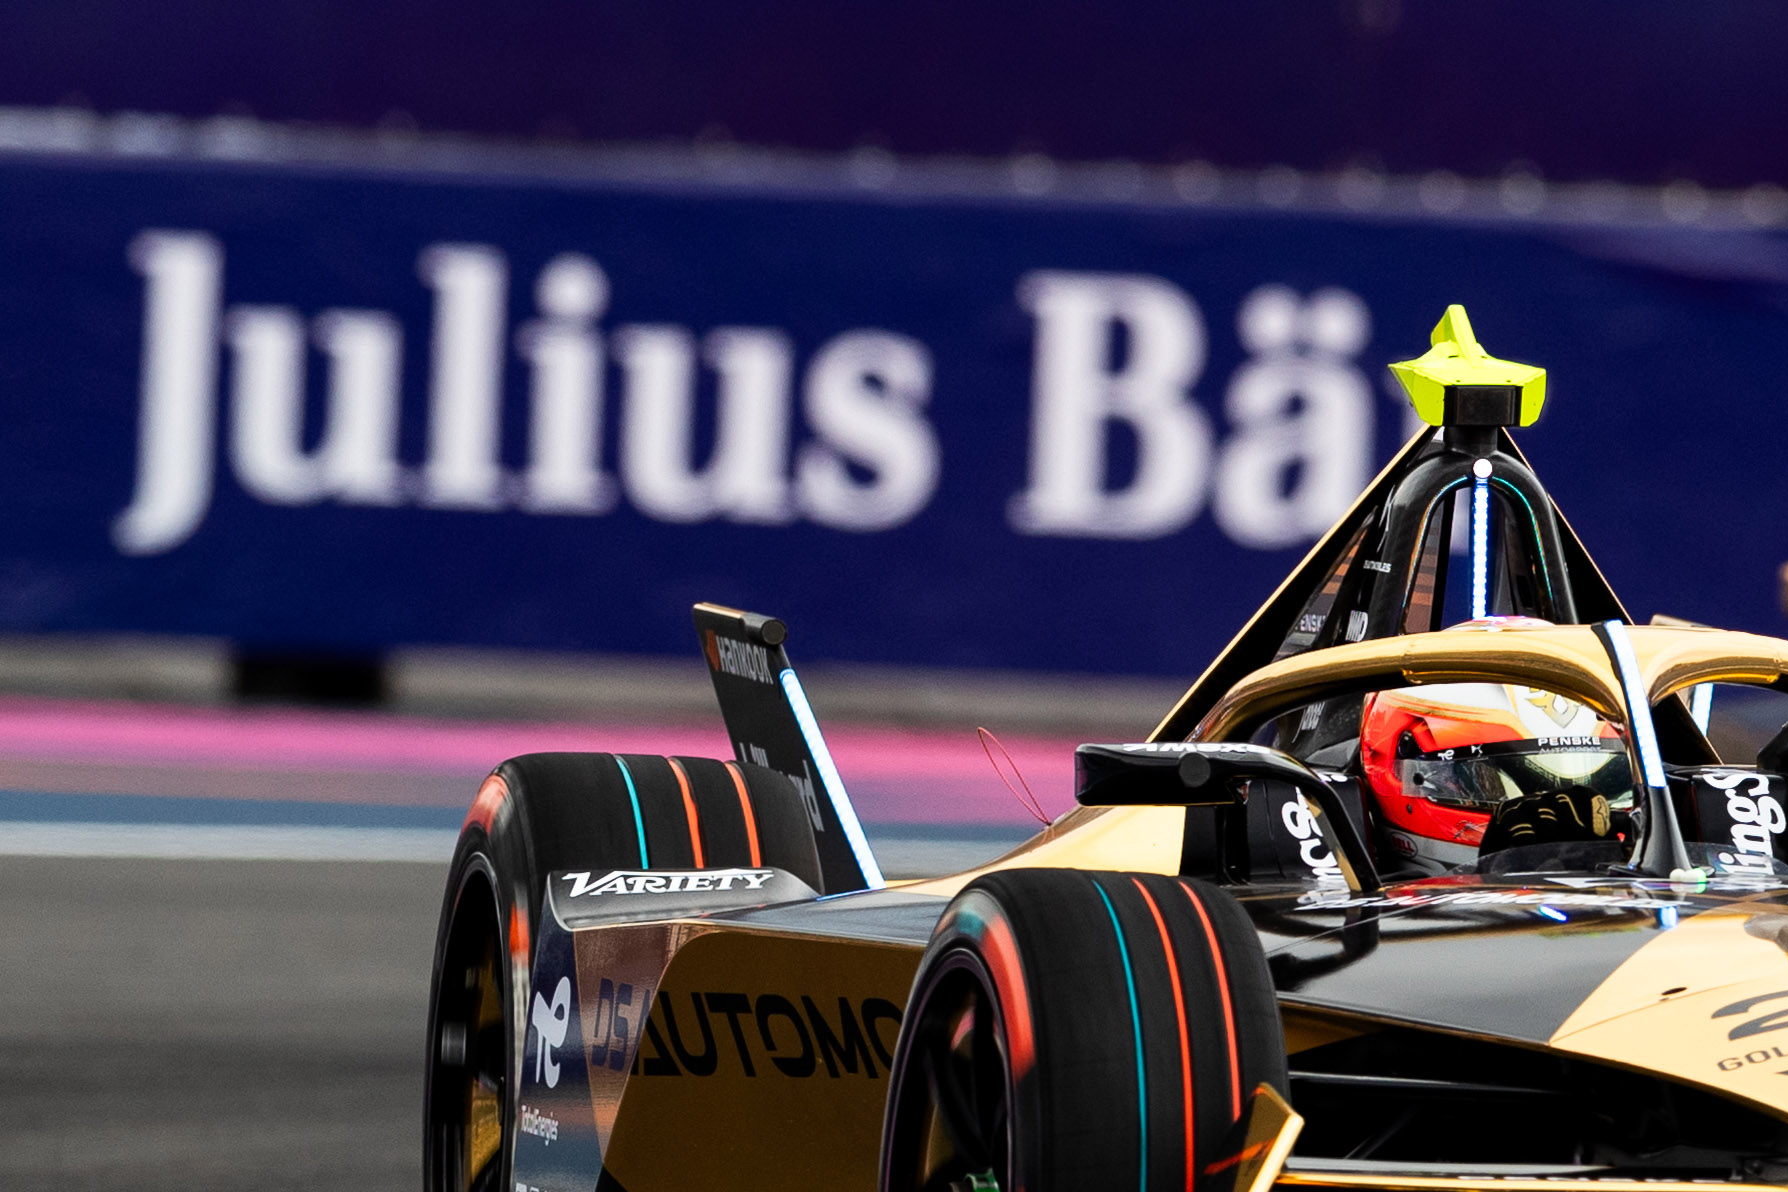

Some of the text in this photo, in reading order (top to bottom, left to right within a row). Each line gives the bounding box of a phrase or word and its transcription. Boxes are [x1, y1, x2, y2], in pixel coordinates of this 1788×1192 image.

[111, 229, 1425, 556] Julius Bä
[1538, 736, 1601, 746] PENSKE
[562, 867, 776, 898] VARIETY
[591, 977, 634, 1072] DS
[521, 1105, 559, 1147] TotalEnergies
